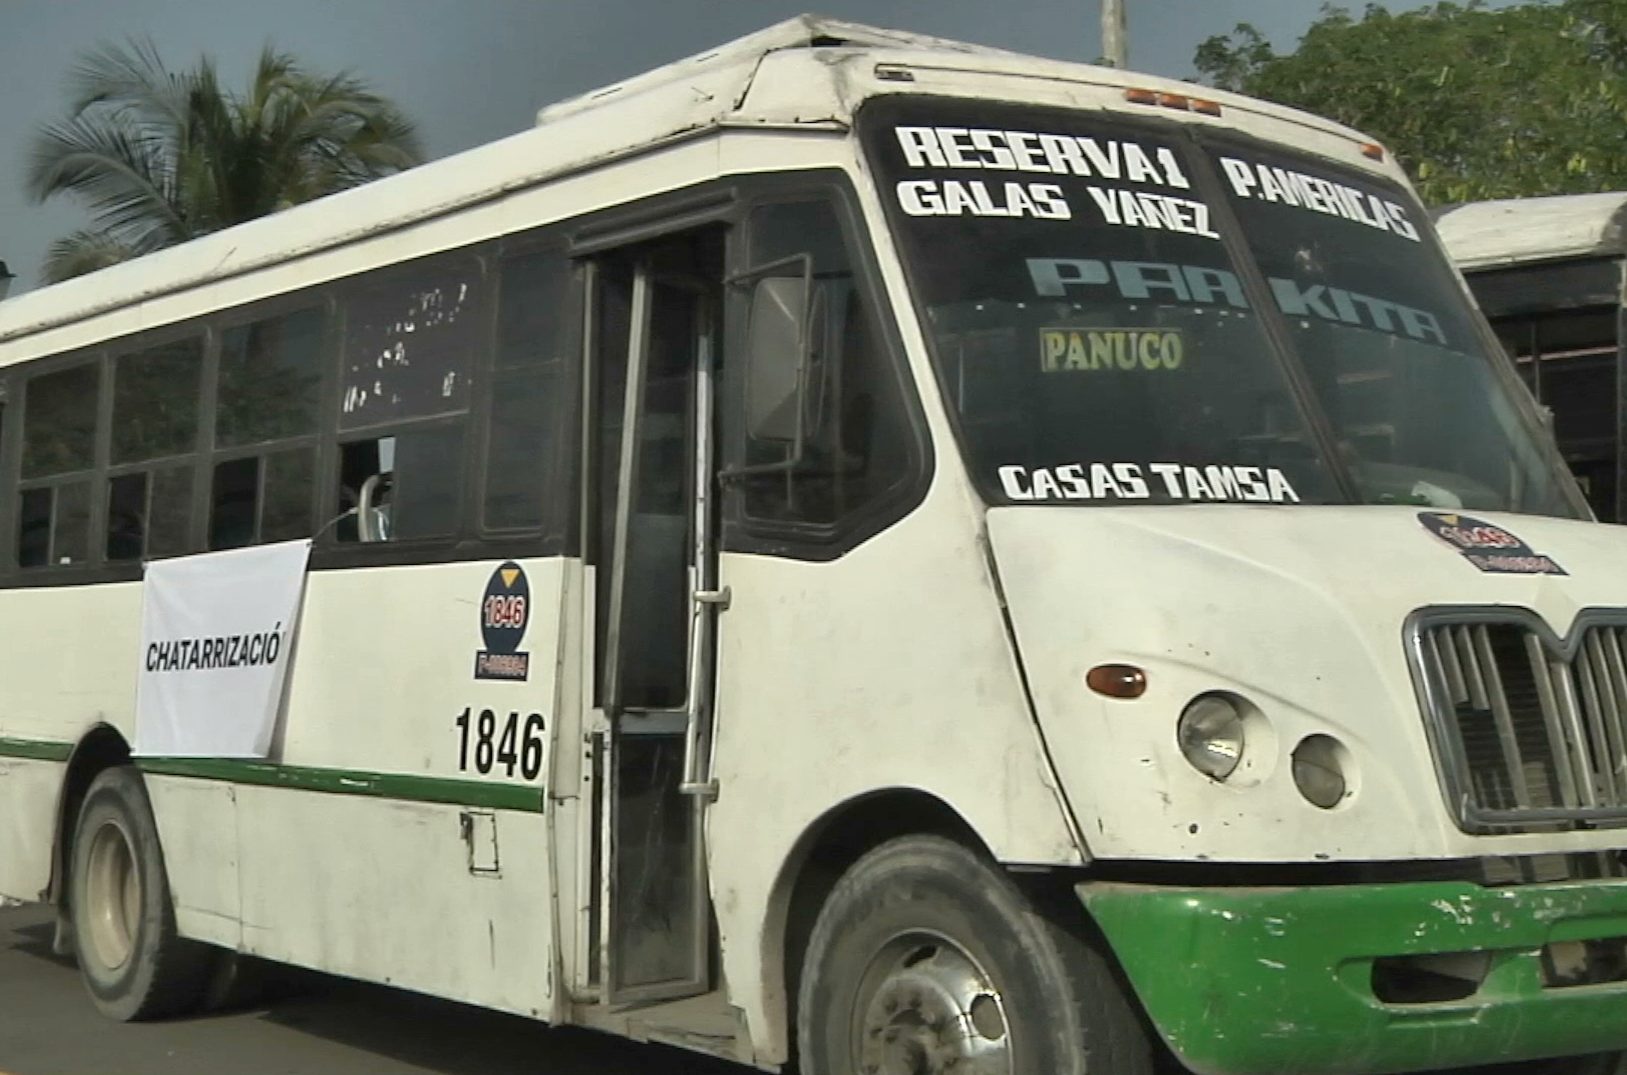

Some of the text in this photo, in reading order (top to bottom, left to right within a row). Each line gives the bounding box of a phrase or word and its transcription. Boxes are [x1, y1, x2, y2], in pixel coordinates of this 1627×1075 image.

[896, 180, 1071, 220] GALAS
[1045, 331, 1183, 369] PANUCO
[998, 462, 1300, 502] CASAS TAMSA
[484, 594, 525, 628] 1846
[146, 621, 286, 672] CHATARRIZACIÓ
[456, 707, 546, 781] 1846
